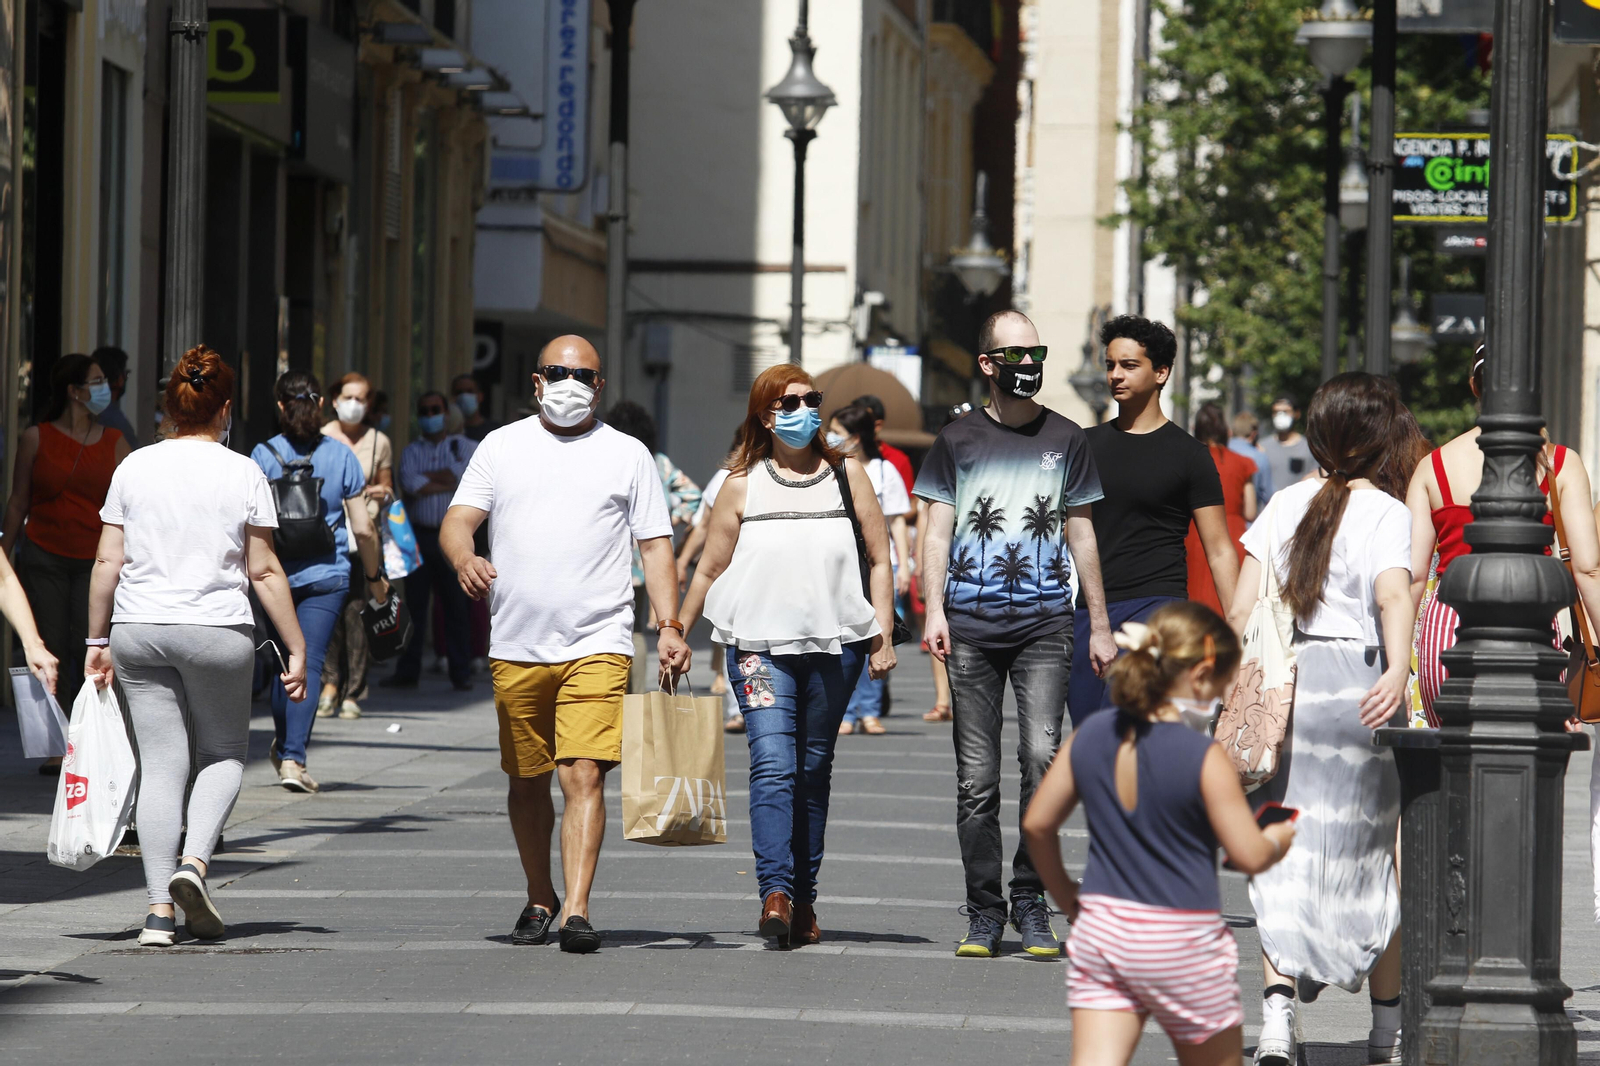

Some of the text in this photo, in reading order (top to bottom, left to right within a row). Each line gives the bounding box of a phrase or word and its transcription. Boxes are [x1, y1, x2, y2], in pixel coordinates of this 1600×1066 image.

[207, 19, 256, 83] B
[1437, 315, 1485, 335] ZA
[654, 776, 727, 836] ZARA
